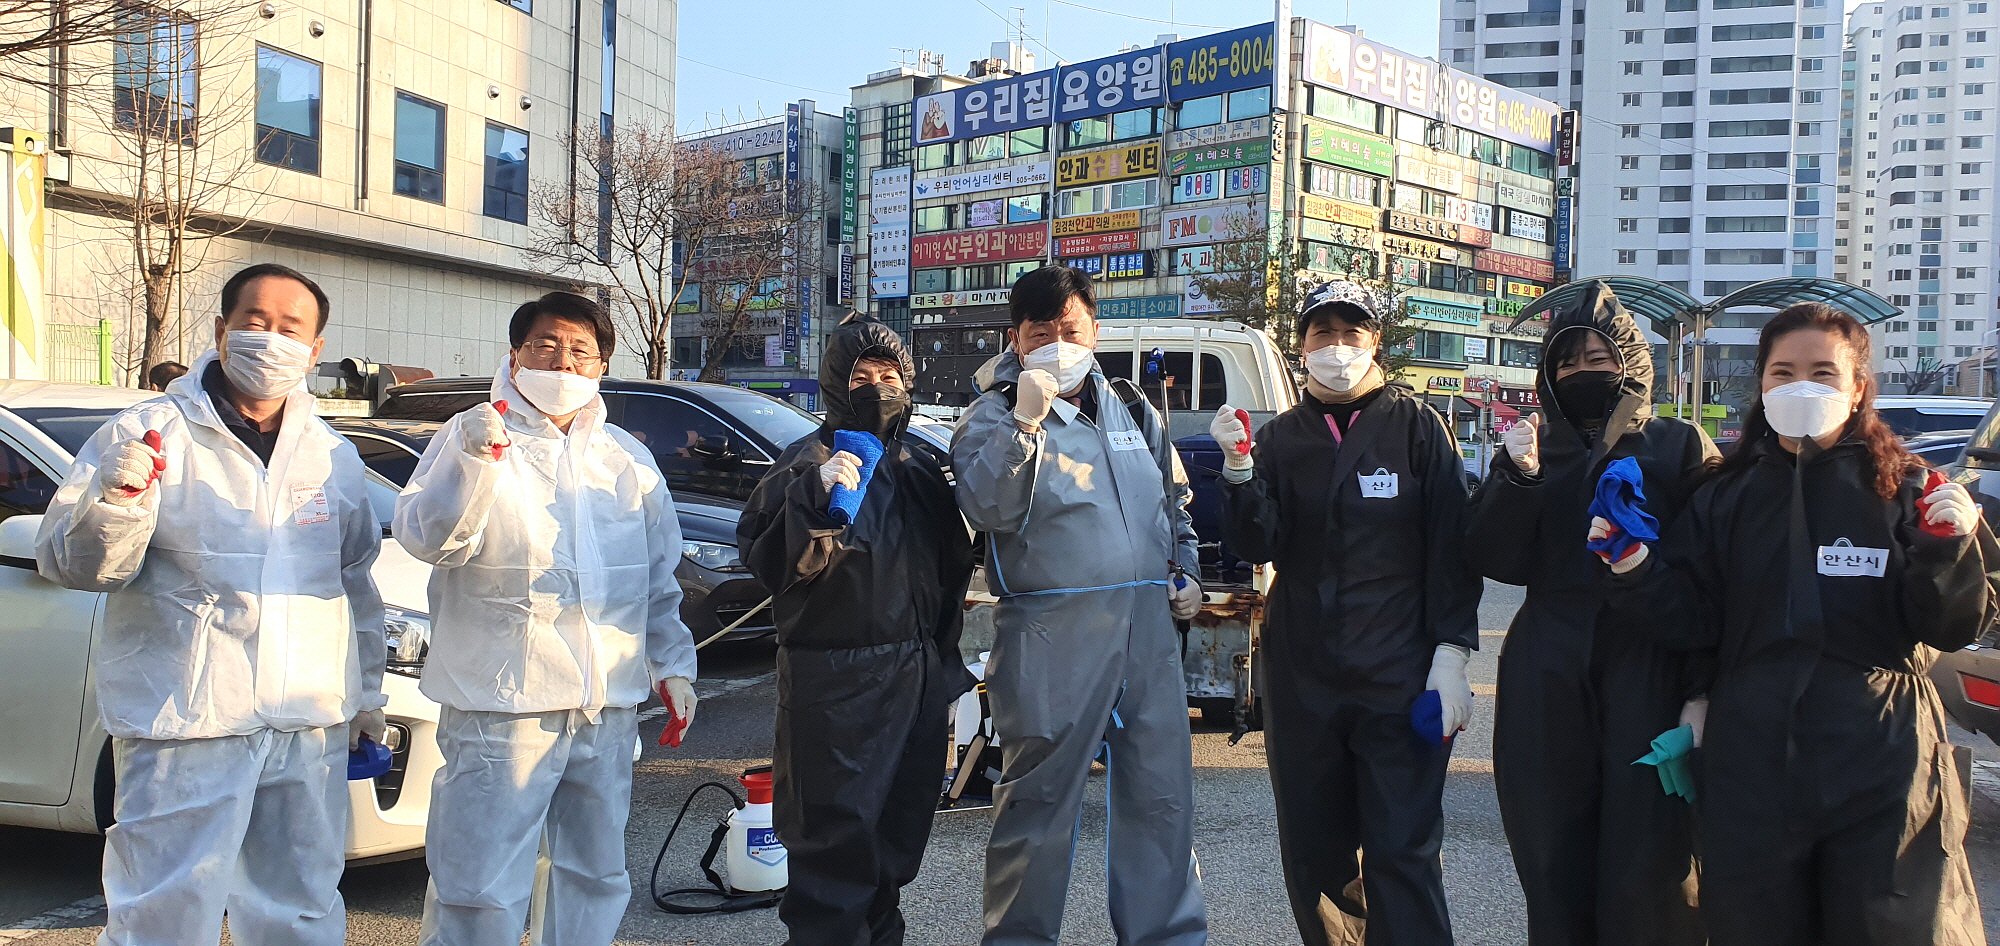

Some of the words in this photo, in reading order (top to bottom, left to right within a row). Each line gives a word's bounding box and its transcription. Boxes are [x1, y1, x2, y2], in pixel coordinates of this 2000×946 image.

[964, 77, 1049, 130] 우리집
[1062, 54, 1160, 113] 요양원
[1188, 34, 1273, 85] 485-8004
[1353, 44, 1428, 111] 우리집
[1508, 100, 1551, 143] 485-8004
[726, 130, 782, 151] 410-2242
[933, 170, 1012, 193] 우리언어심리센터
[1559, 178, 1571, 189] PC
[1169, 215, 1197, 239] FM
[914, 238, 941, 260] 이기영
[943, 231, 1008, 261] 산부인과
[1009, 231, 1044, 251] 야간분만
[882, 282, 897, 290] 약국
[915, 295, 937, 306] 태국
[1148, 299, 1176, 314] 소아과
[1823, 554, 1879, 569] 안산시
[764, 833, 778, 844] CO
